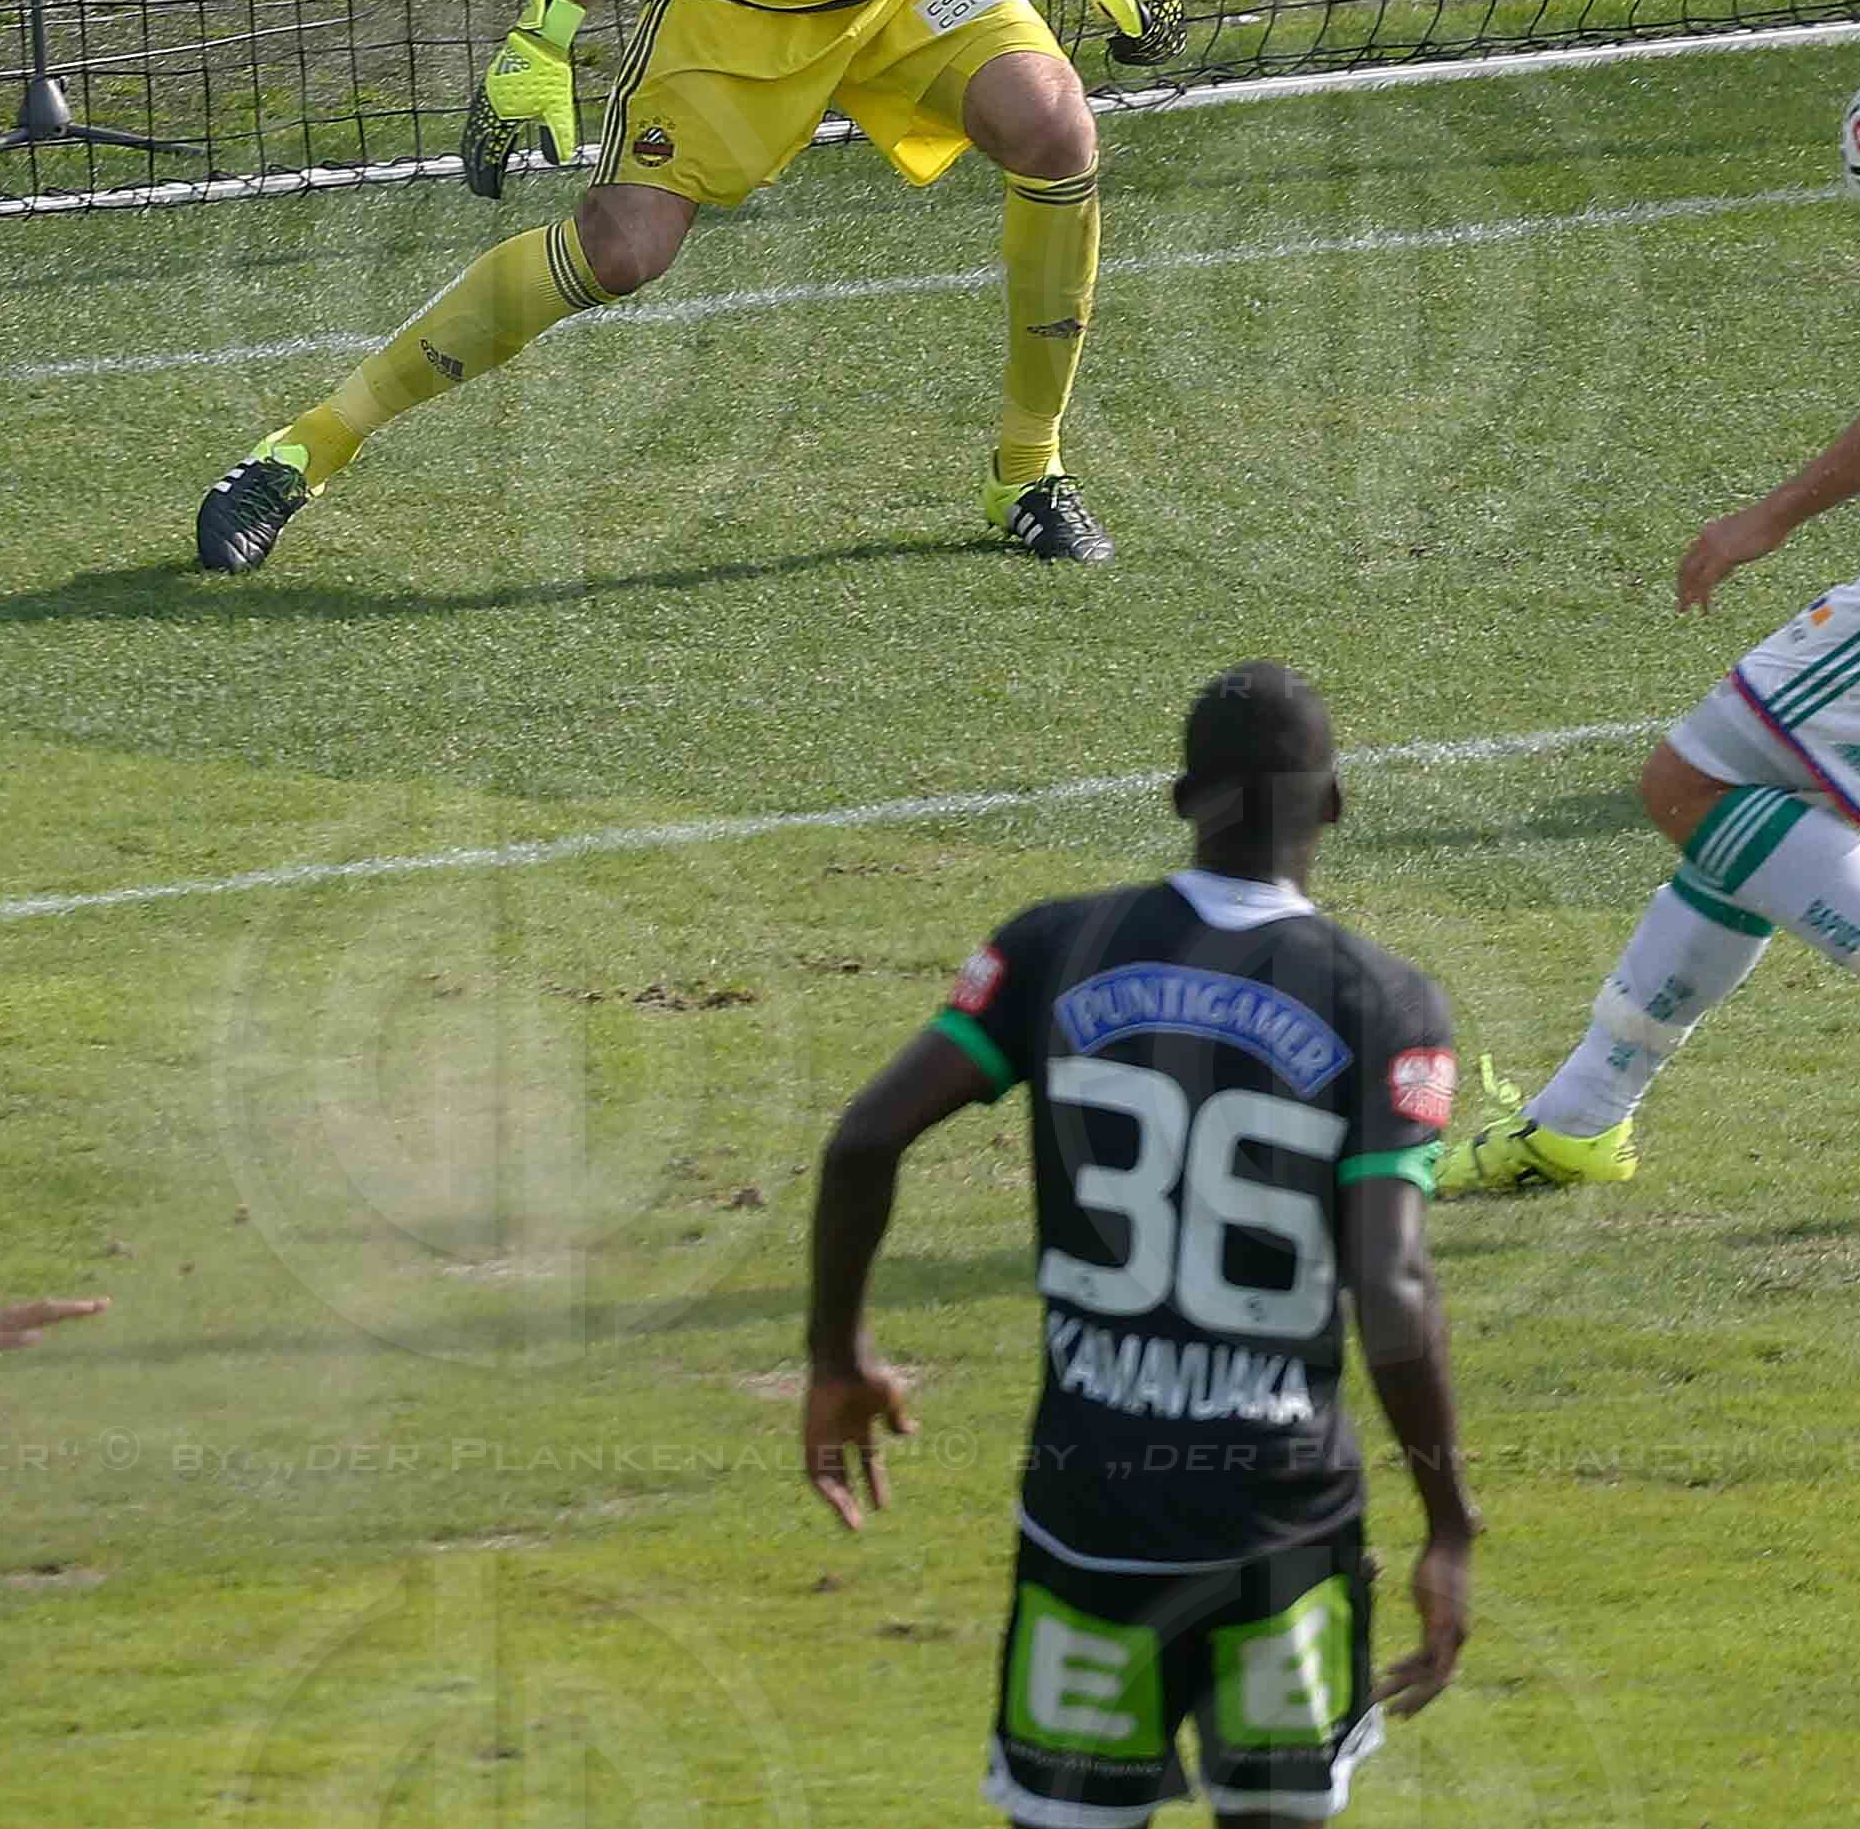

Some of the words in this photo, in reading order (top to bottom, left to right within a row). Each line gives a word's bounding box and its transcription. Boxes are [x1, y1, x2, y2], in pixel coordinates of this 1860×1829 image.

[1071, 976, 1336, 1078] PUNTIGAMER
[1038, 1055, 1350, 1340] 36
[1028, 1614, 1137, 1743] E
